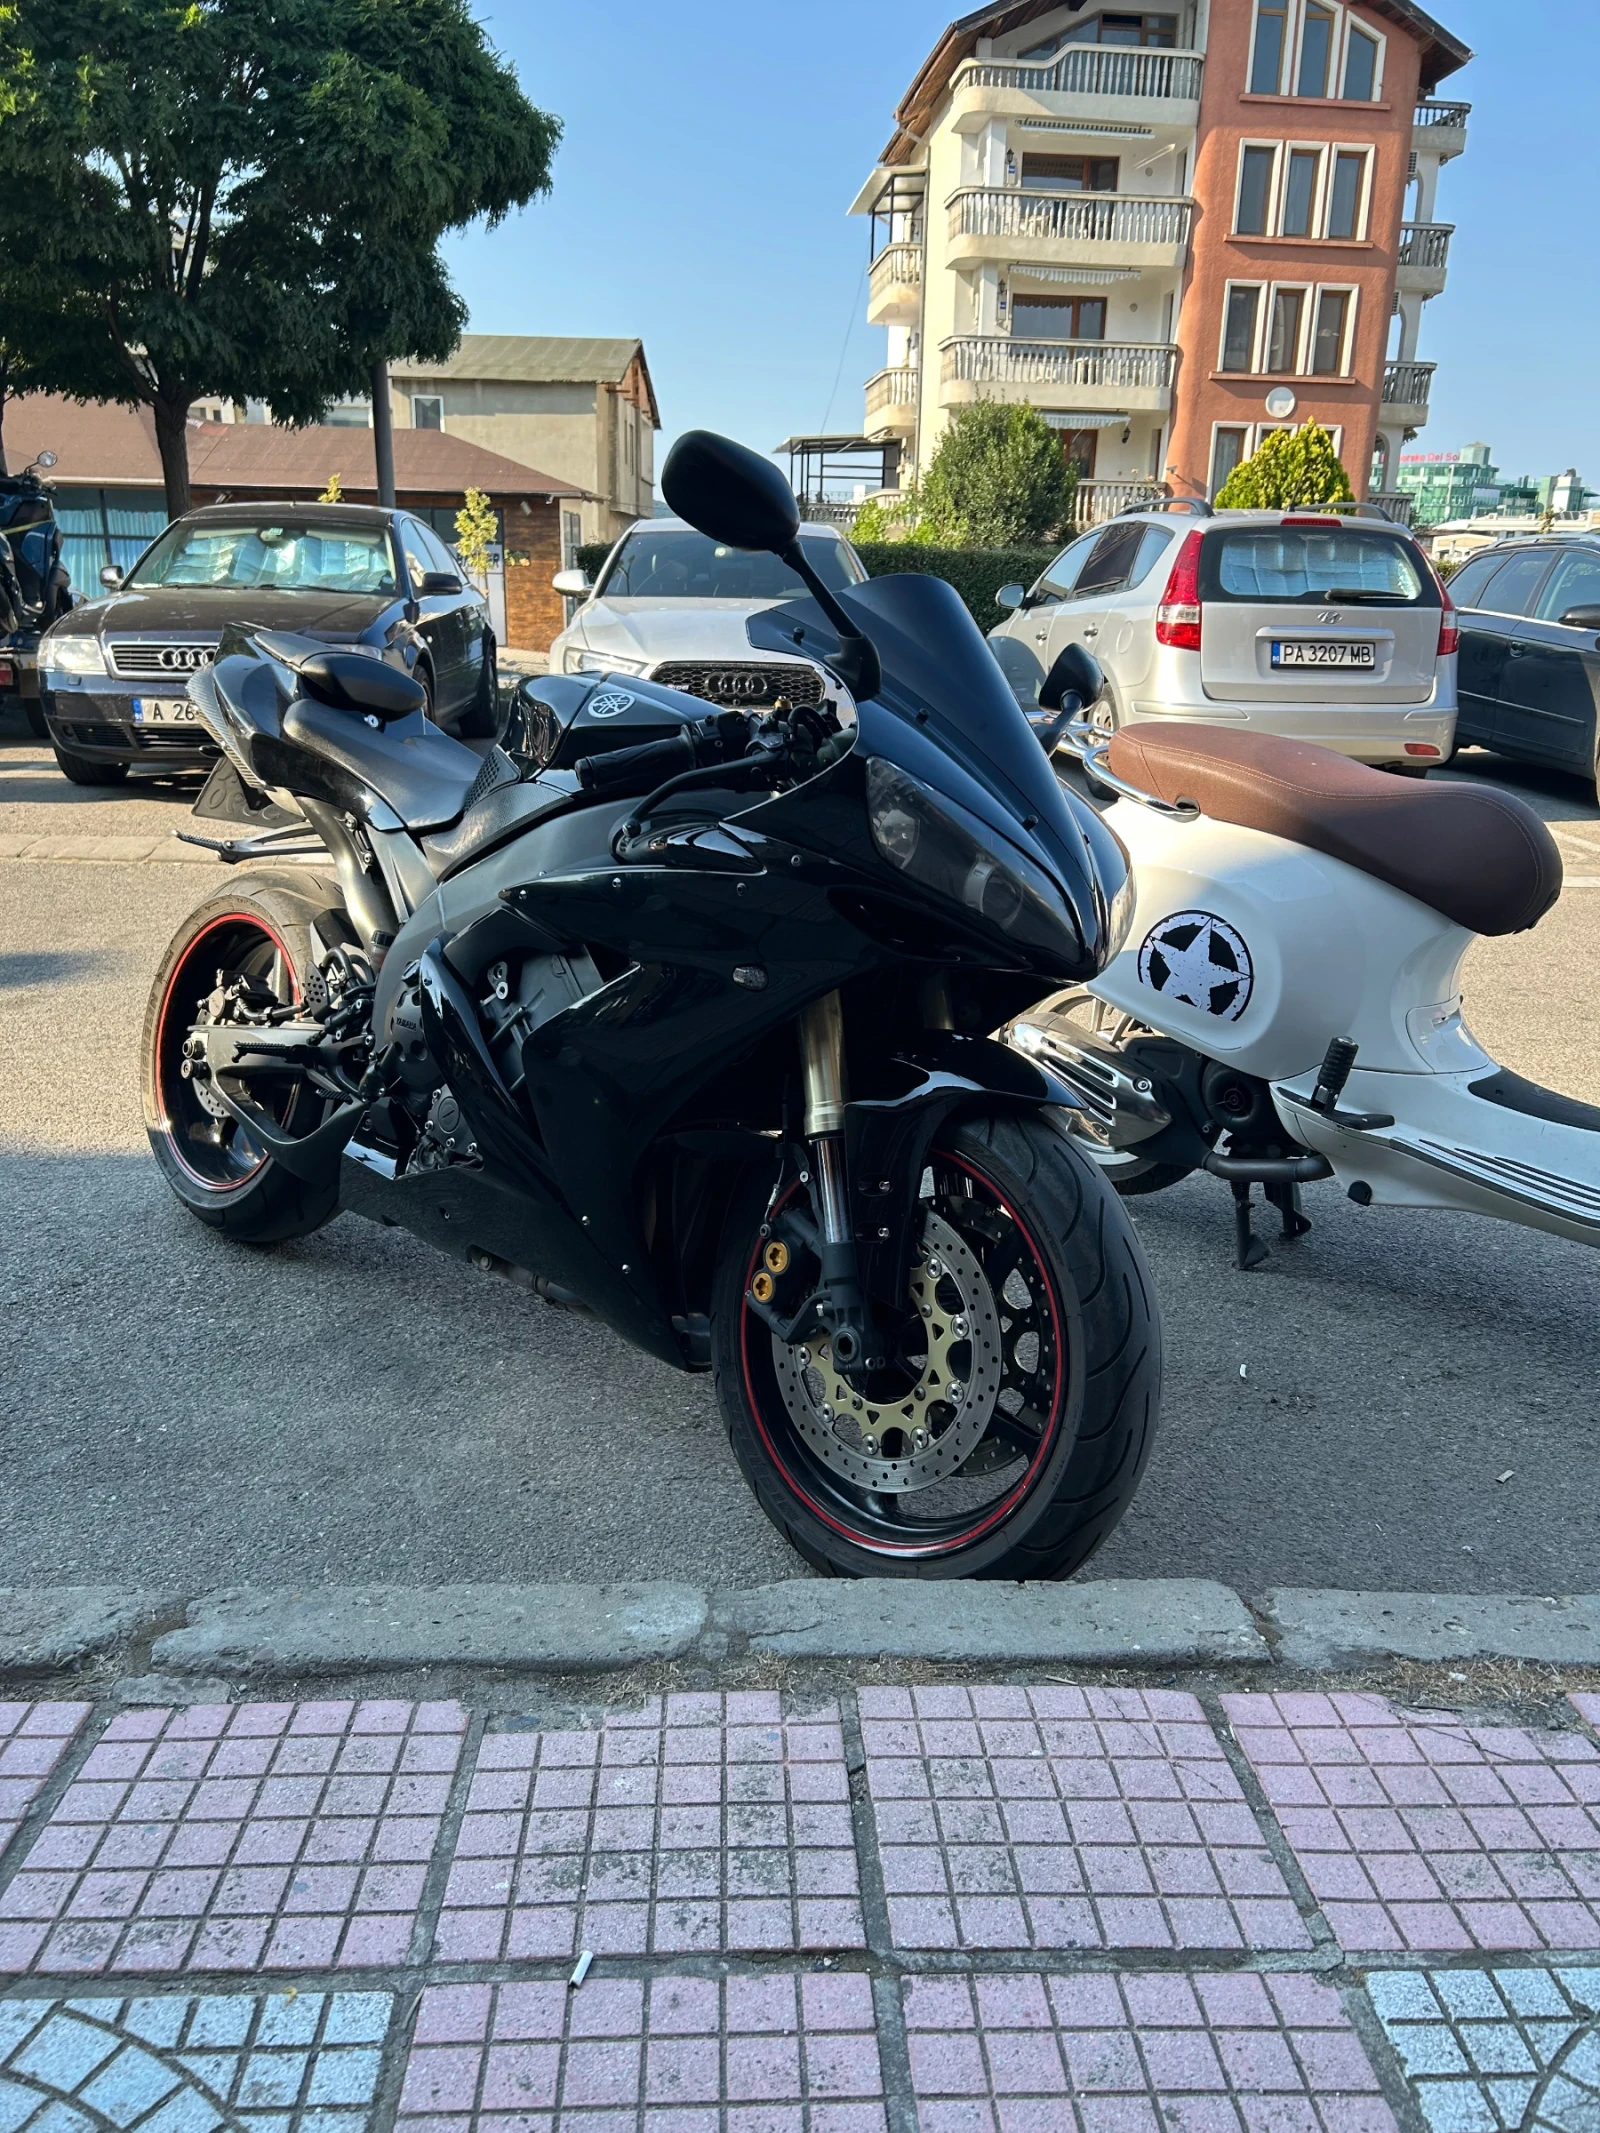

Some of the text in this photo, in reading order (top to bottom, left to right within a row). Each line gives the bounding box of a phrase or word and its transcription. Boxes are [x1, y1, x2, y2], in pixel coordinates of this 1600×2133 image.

[1427, 452, 1443, 461] Del
[1283, 645, 1371, 663] PA 3207 MB
[152, 703, 164, 721] A
[142, 991, 158, 1095] MICHELIN
